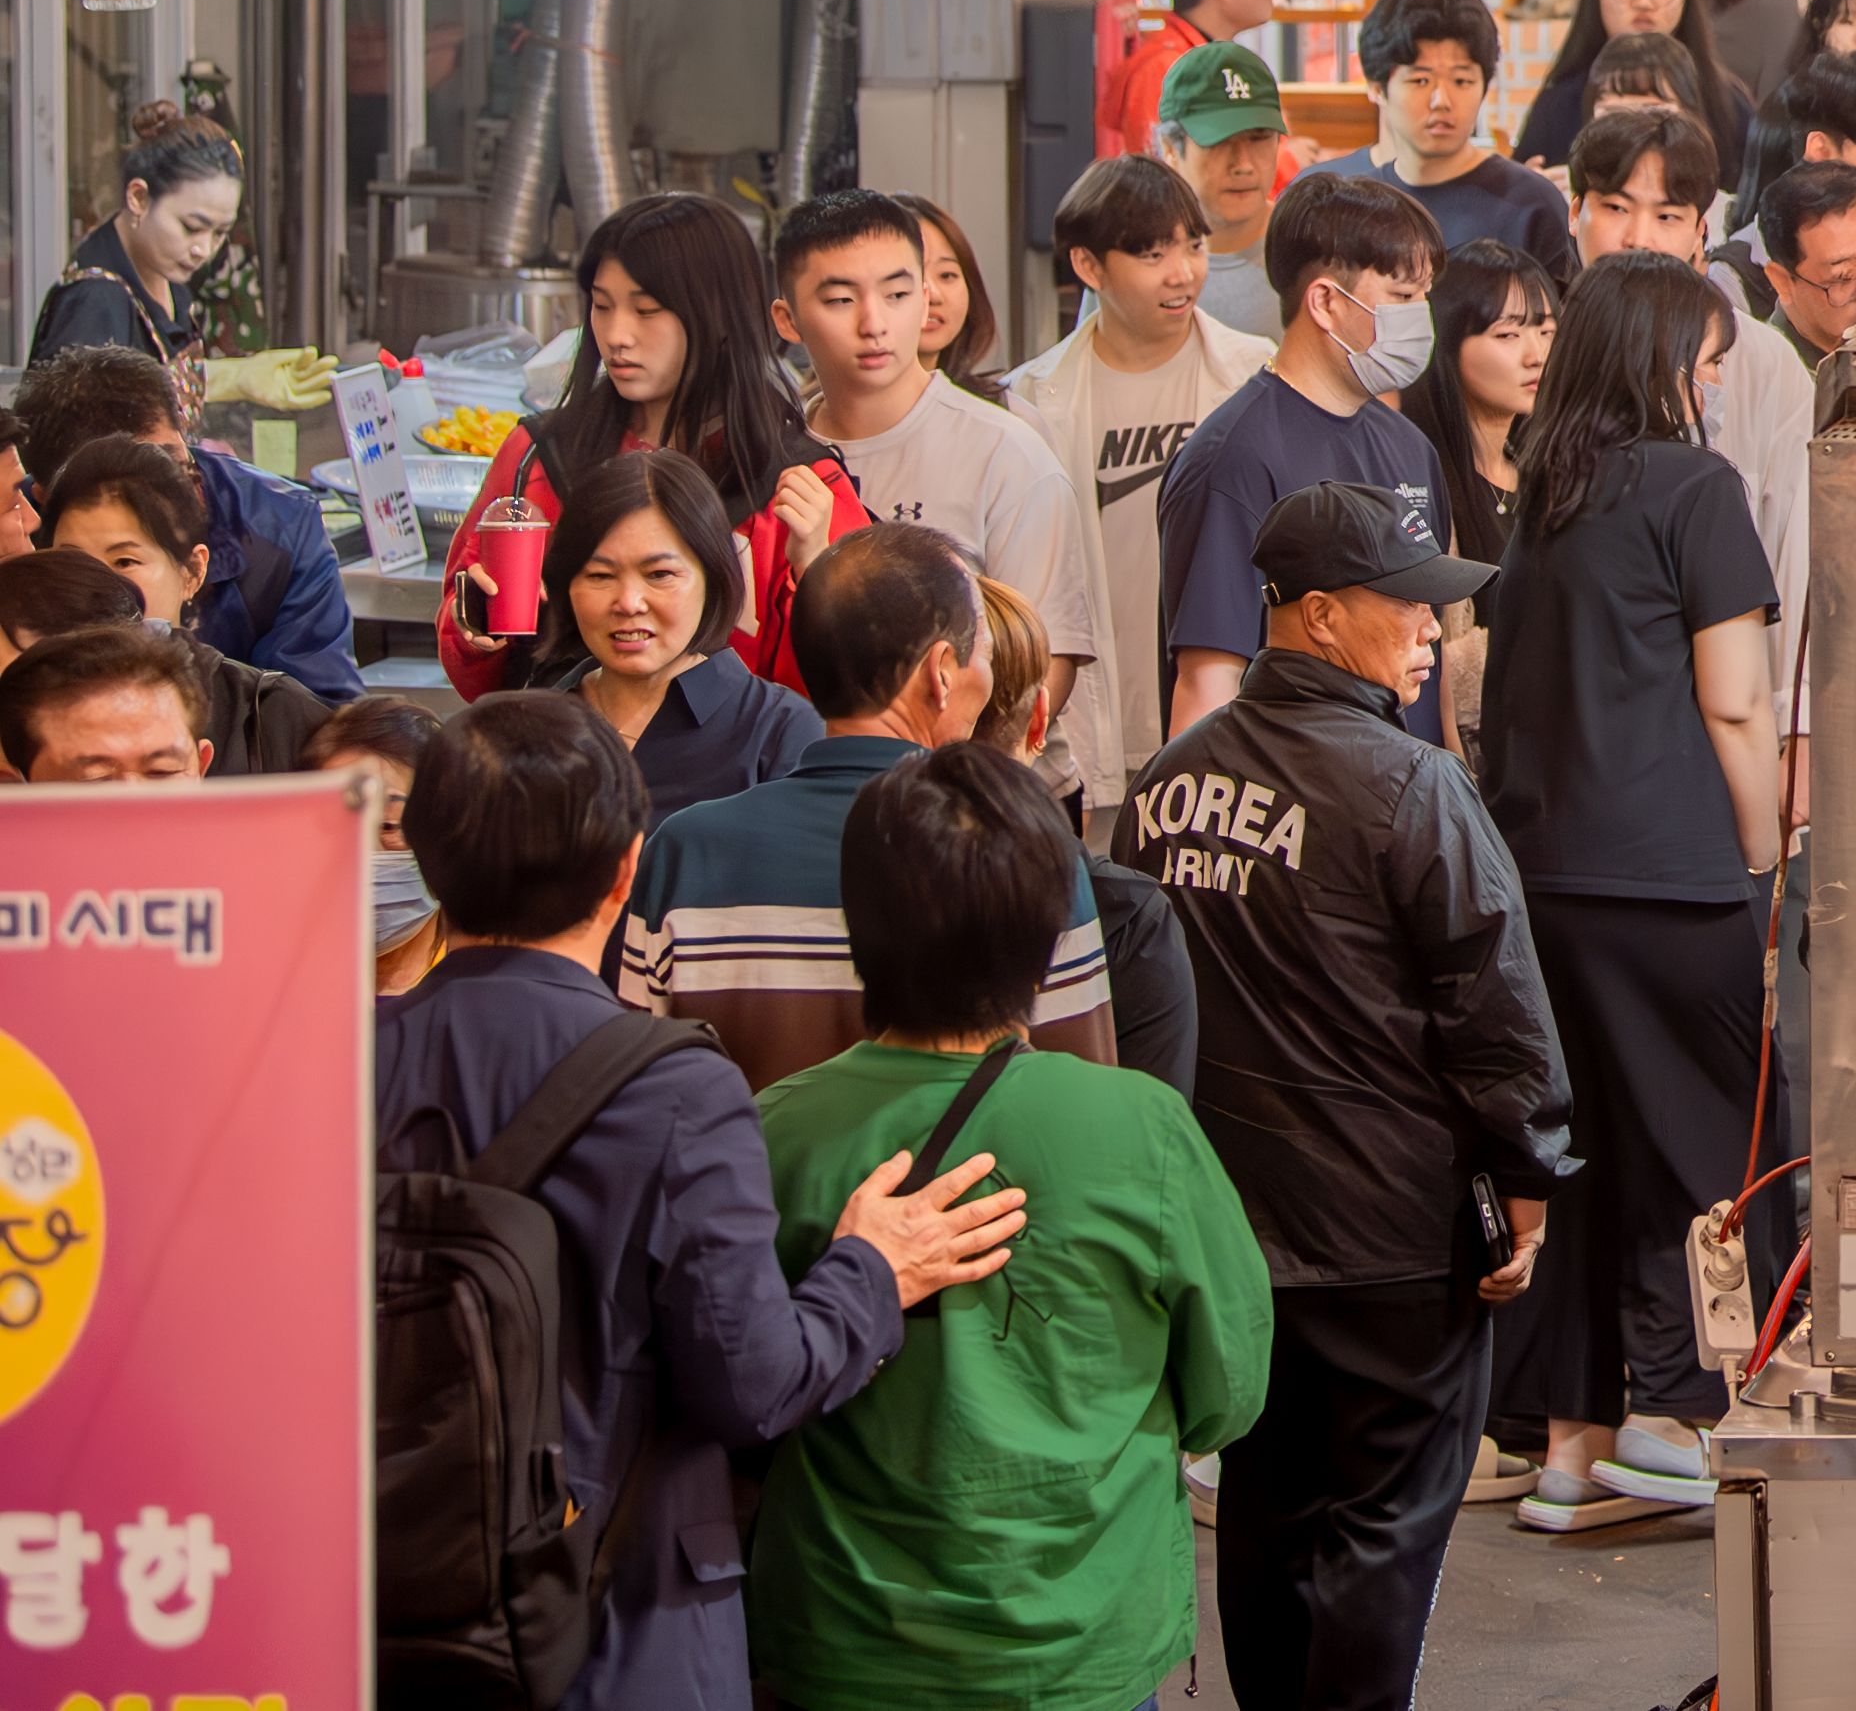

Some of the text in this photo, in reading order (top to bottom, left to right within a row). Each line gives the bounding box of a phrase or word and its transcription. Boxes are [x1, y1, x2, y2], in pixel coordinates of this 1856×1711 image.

[1221, 68, 1251, 99] LA
[1099, 421, 1194, 470] NIKE
[1133, 772, 1306, 870] KOREA
[1163, 846, 1255, 895] ARMY
[63, 889, 222, 965] 시대
